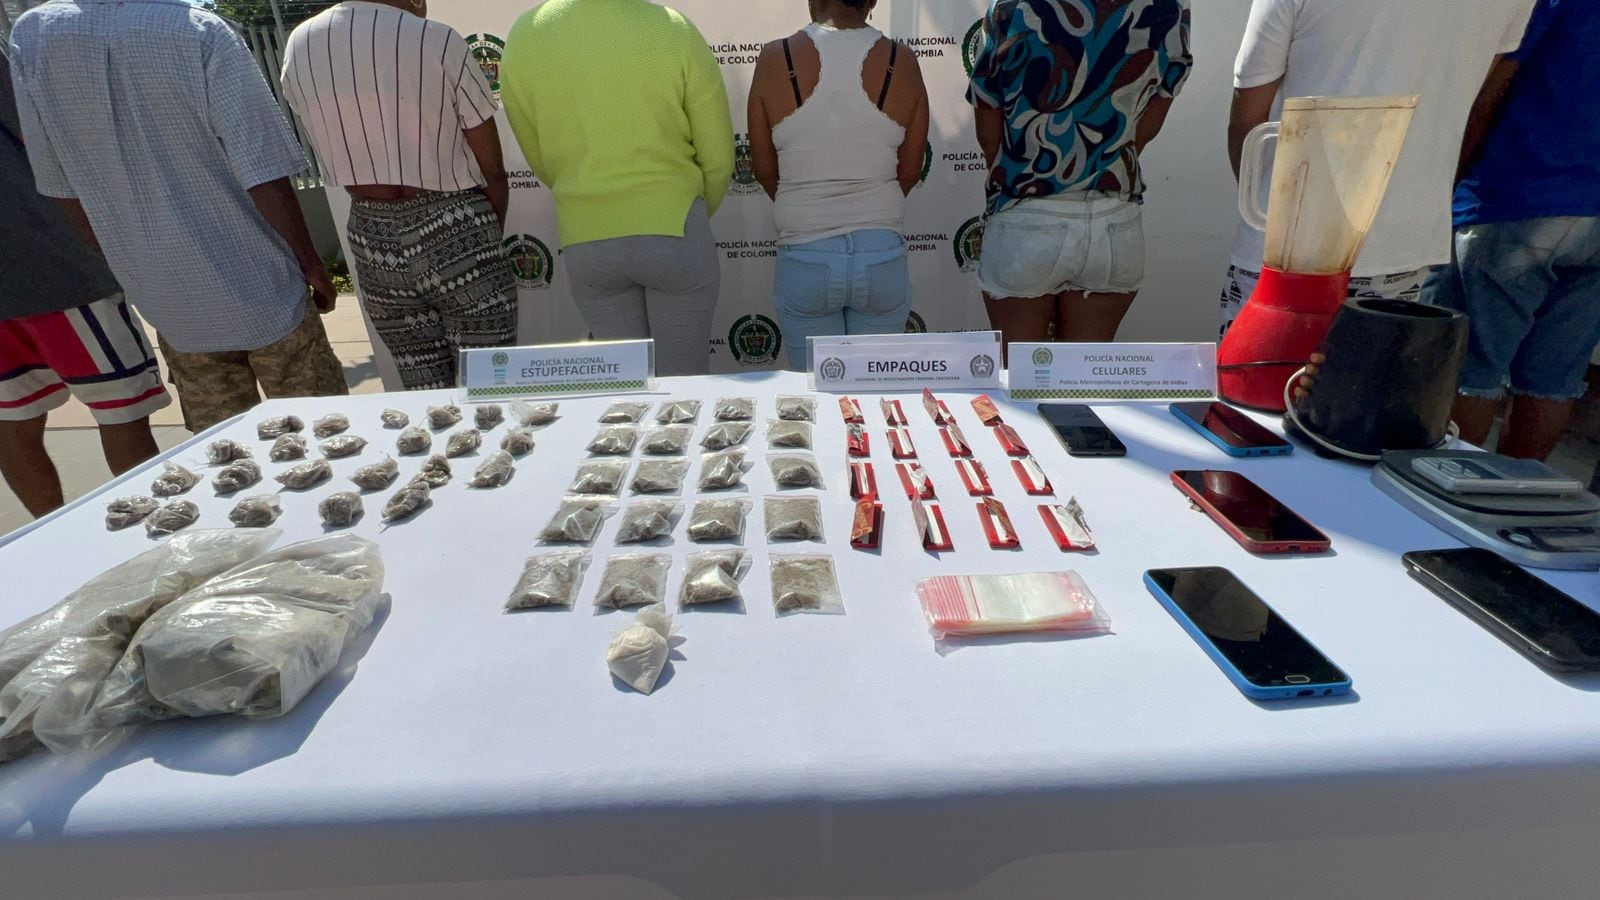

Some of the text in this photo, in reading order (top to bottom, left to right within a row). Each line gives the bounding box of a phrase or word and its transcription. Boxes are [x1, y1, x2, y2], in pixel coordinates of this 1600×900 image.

[907, 36, 957, 46] NACIONAL
[913, 49, 944, 57] OMBIA
[942, 151, 978, 161] POLICÍA
[509, 181, 541, 189] OMBIA
[903, 233, 949, 242] NACIONAL
[714, 240, 749, 249] POLICÍA
[727, 250, 778, 259] DE COLOMB
[530, 355, 606, 367] POLICÍA NACIONAL
[1083, 354, 1155, 363] POLICÍA NACIONAL
[521, 363, 620, 378] ESTUPEFACIENTE
[868, 360, 948, 373] EMPAQUES
[1092, 366, 1147, 376] CELULARES
[1080, 379, 1121, 387] Metropolitana
[1131, 379, 1161, 387] Cartagena
